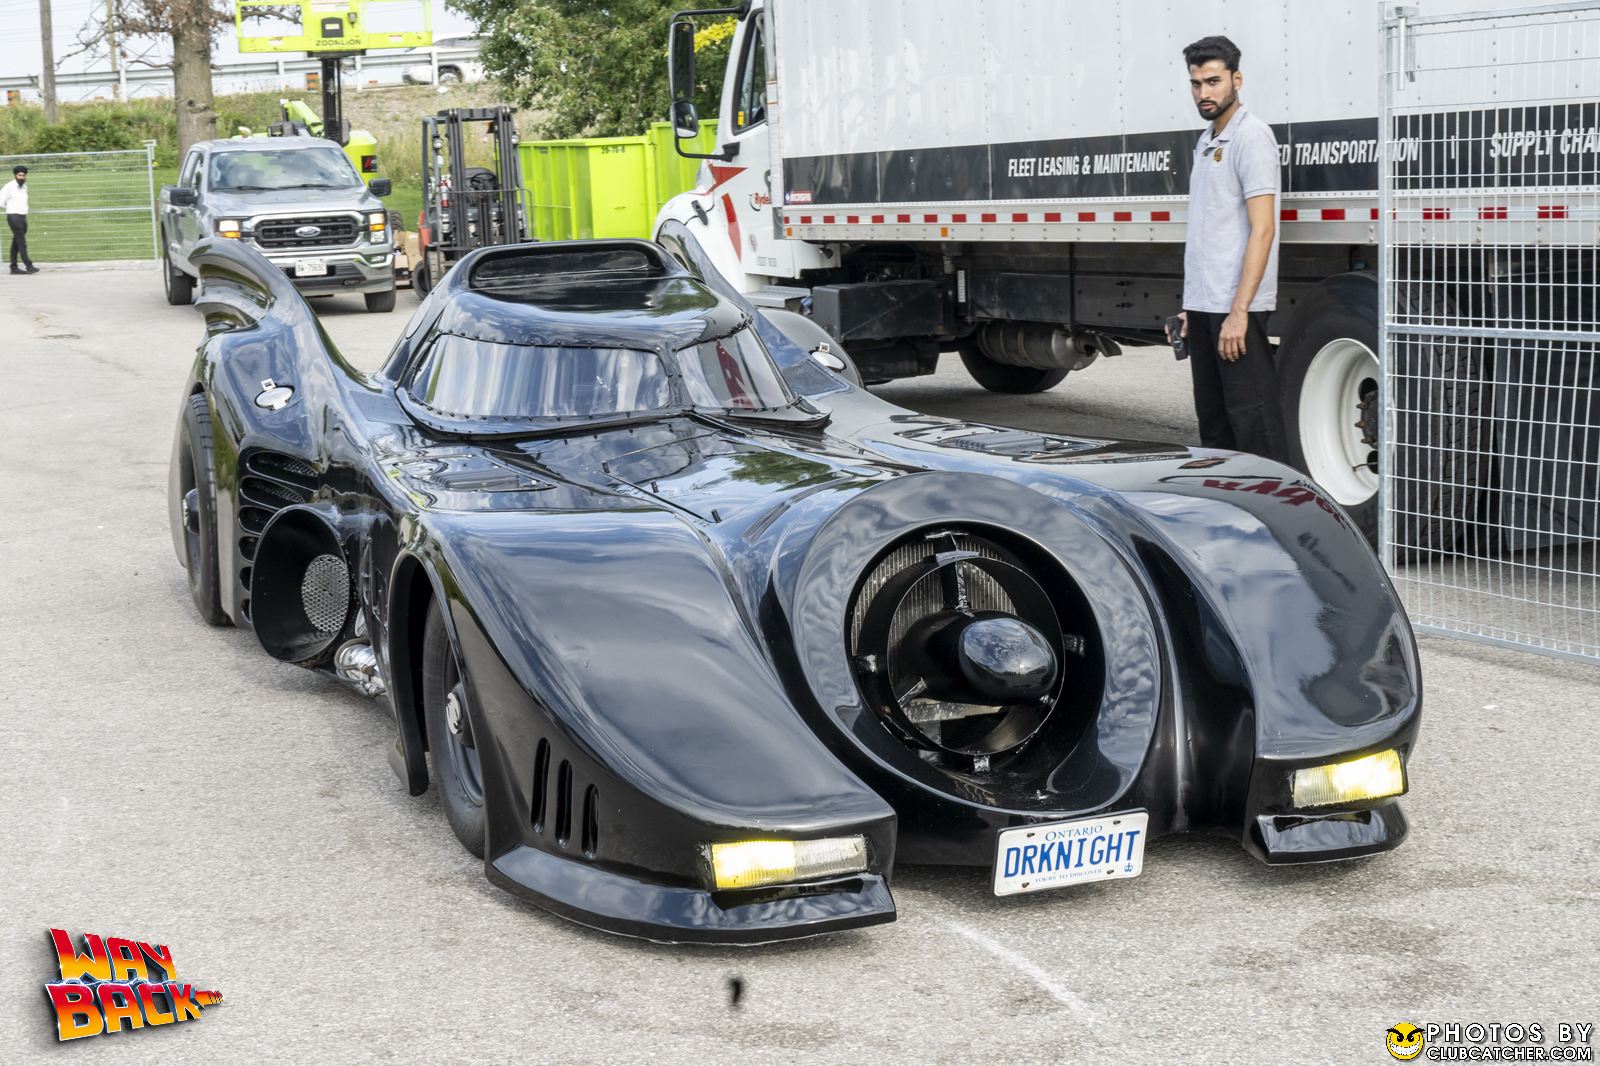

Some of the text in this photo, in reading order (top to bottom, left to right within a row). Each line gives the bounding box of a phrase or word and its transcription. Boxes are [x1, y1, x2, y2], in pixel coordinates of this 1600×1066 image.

[1295, 137, 1419, 165] TRANSPORTAION
[1489, 129, 1556, 158] SUPPLY
[1008, 150, 1171, 177] FLEET LEASING & MAINTENANCE
[1045, 825, 1103, 841] ONTARIO
[1004, 830, 1140, 878] DRKNIGHT
[1035, 875, 1057, 883] YOURS
[1069, 868, 1102, 878] DISCOVER
